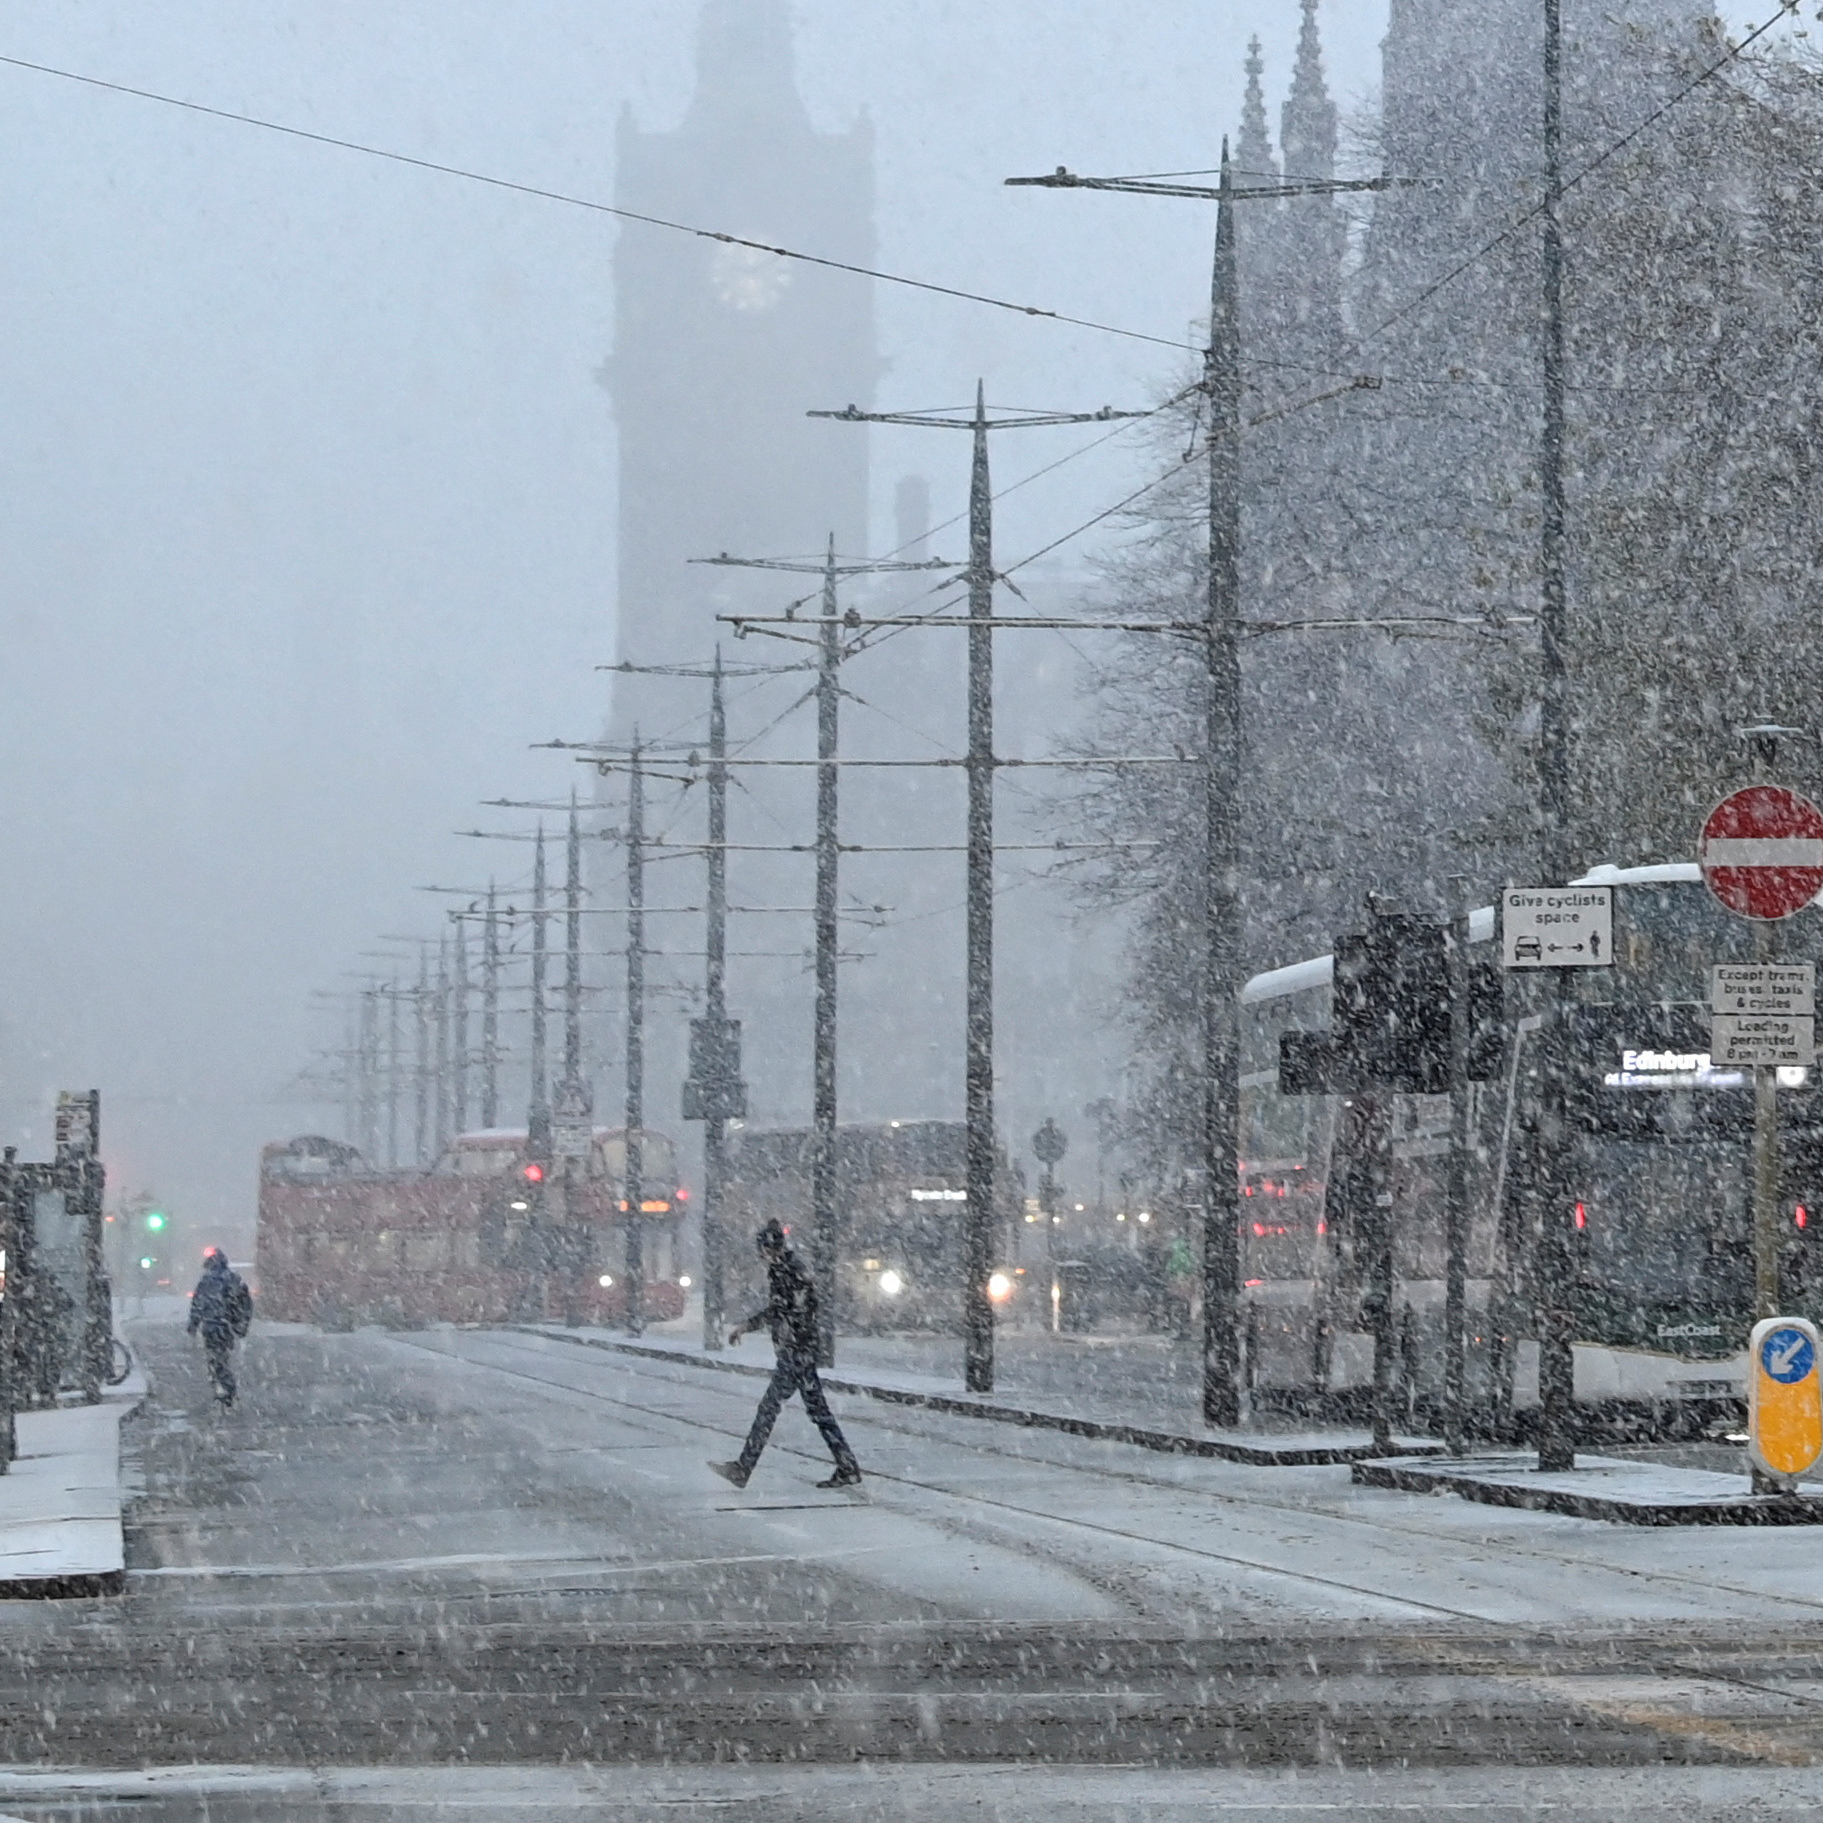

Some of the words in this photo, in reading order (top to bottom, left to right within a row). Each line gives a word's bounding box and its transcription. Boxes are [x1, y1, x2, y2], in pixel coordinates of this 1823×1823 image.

[1509, 894, 1543, 907] Give
[1547, 893, 1606, 908] cyclists
[1535, 913, 1580, 925] space
[1718, 969, 1763, 982] Except
[1772, 984, 1803, 995] taxis
[1736, 997, 1745, 1008] &
[1749, 997, 1791, 1011] cycles
[1737, 1020, 1789, 1034] Loading
[1730, 1034, 1796, 1046] permitted
[1623, 1050, 1712, 1073] Edinburg
